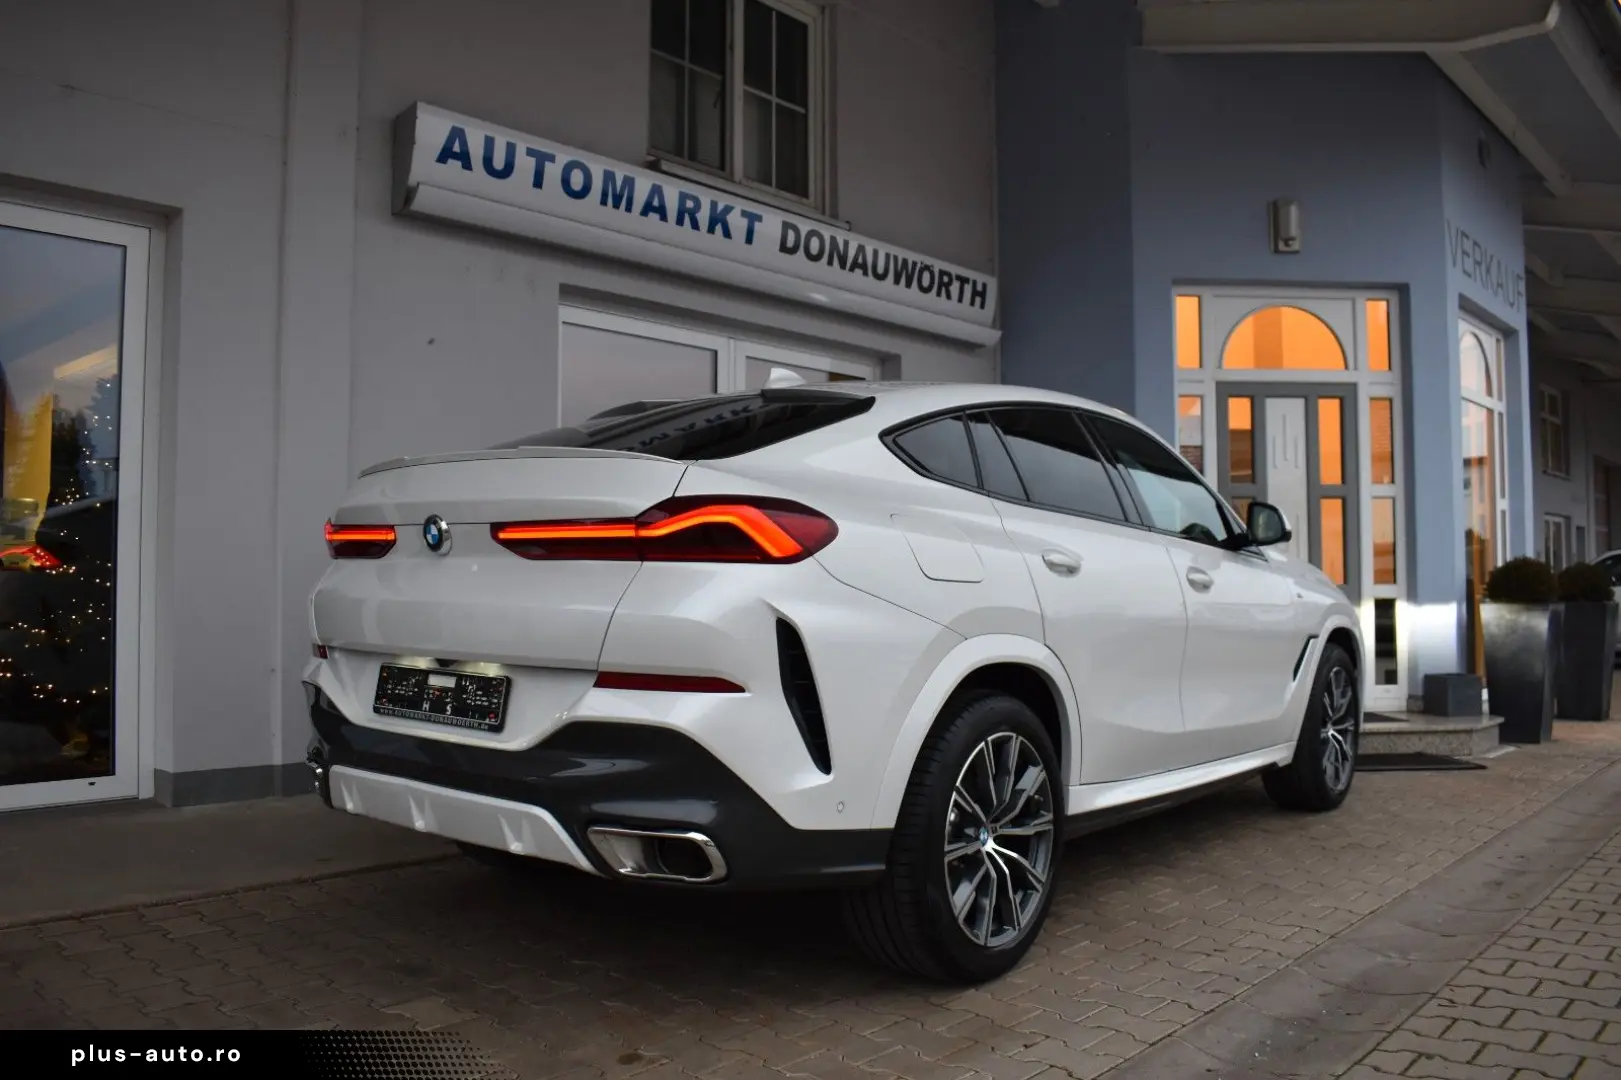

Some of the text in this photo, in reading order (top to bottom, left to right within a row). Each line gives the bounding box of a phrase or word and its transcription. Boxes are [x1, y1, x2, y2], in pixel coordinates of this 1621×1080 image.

[435, 124, 988, 310] AUTOMARKT DONAUWÖRTH
[1446, 218, 1525, 313] VERKAUF
